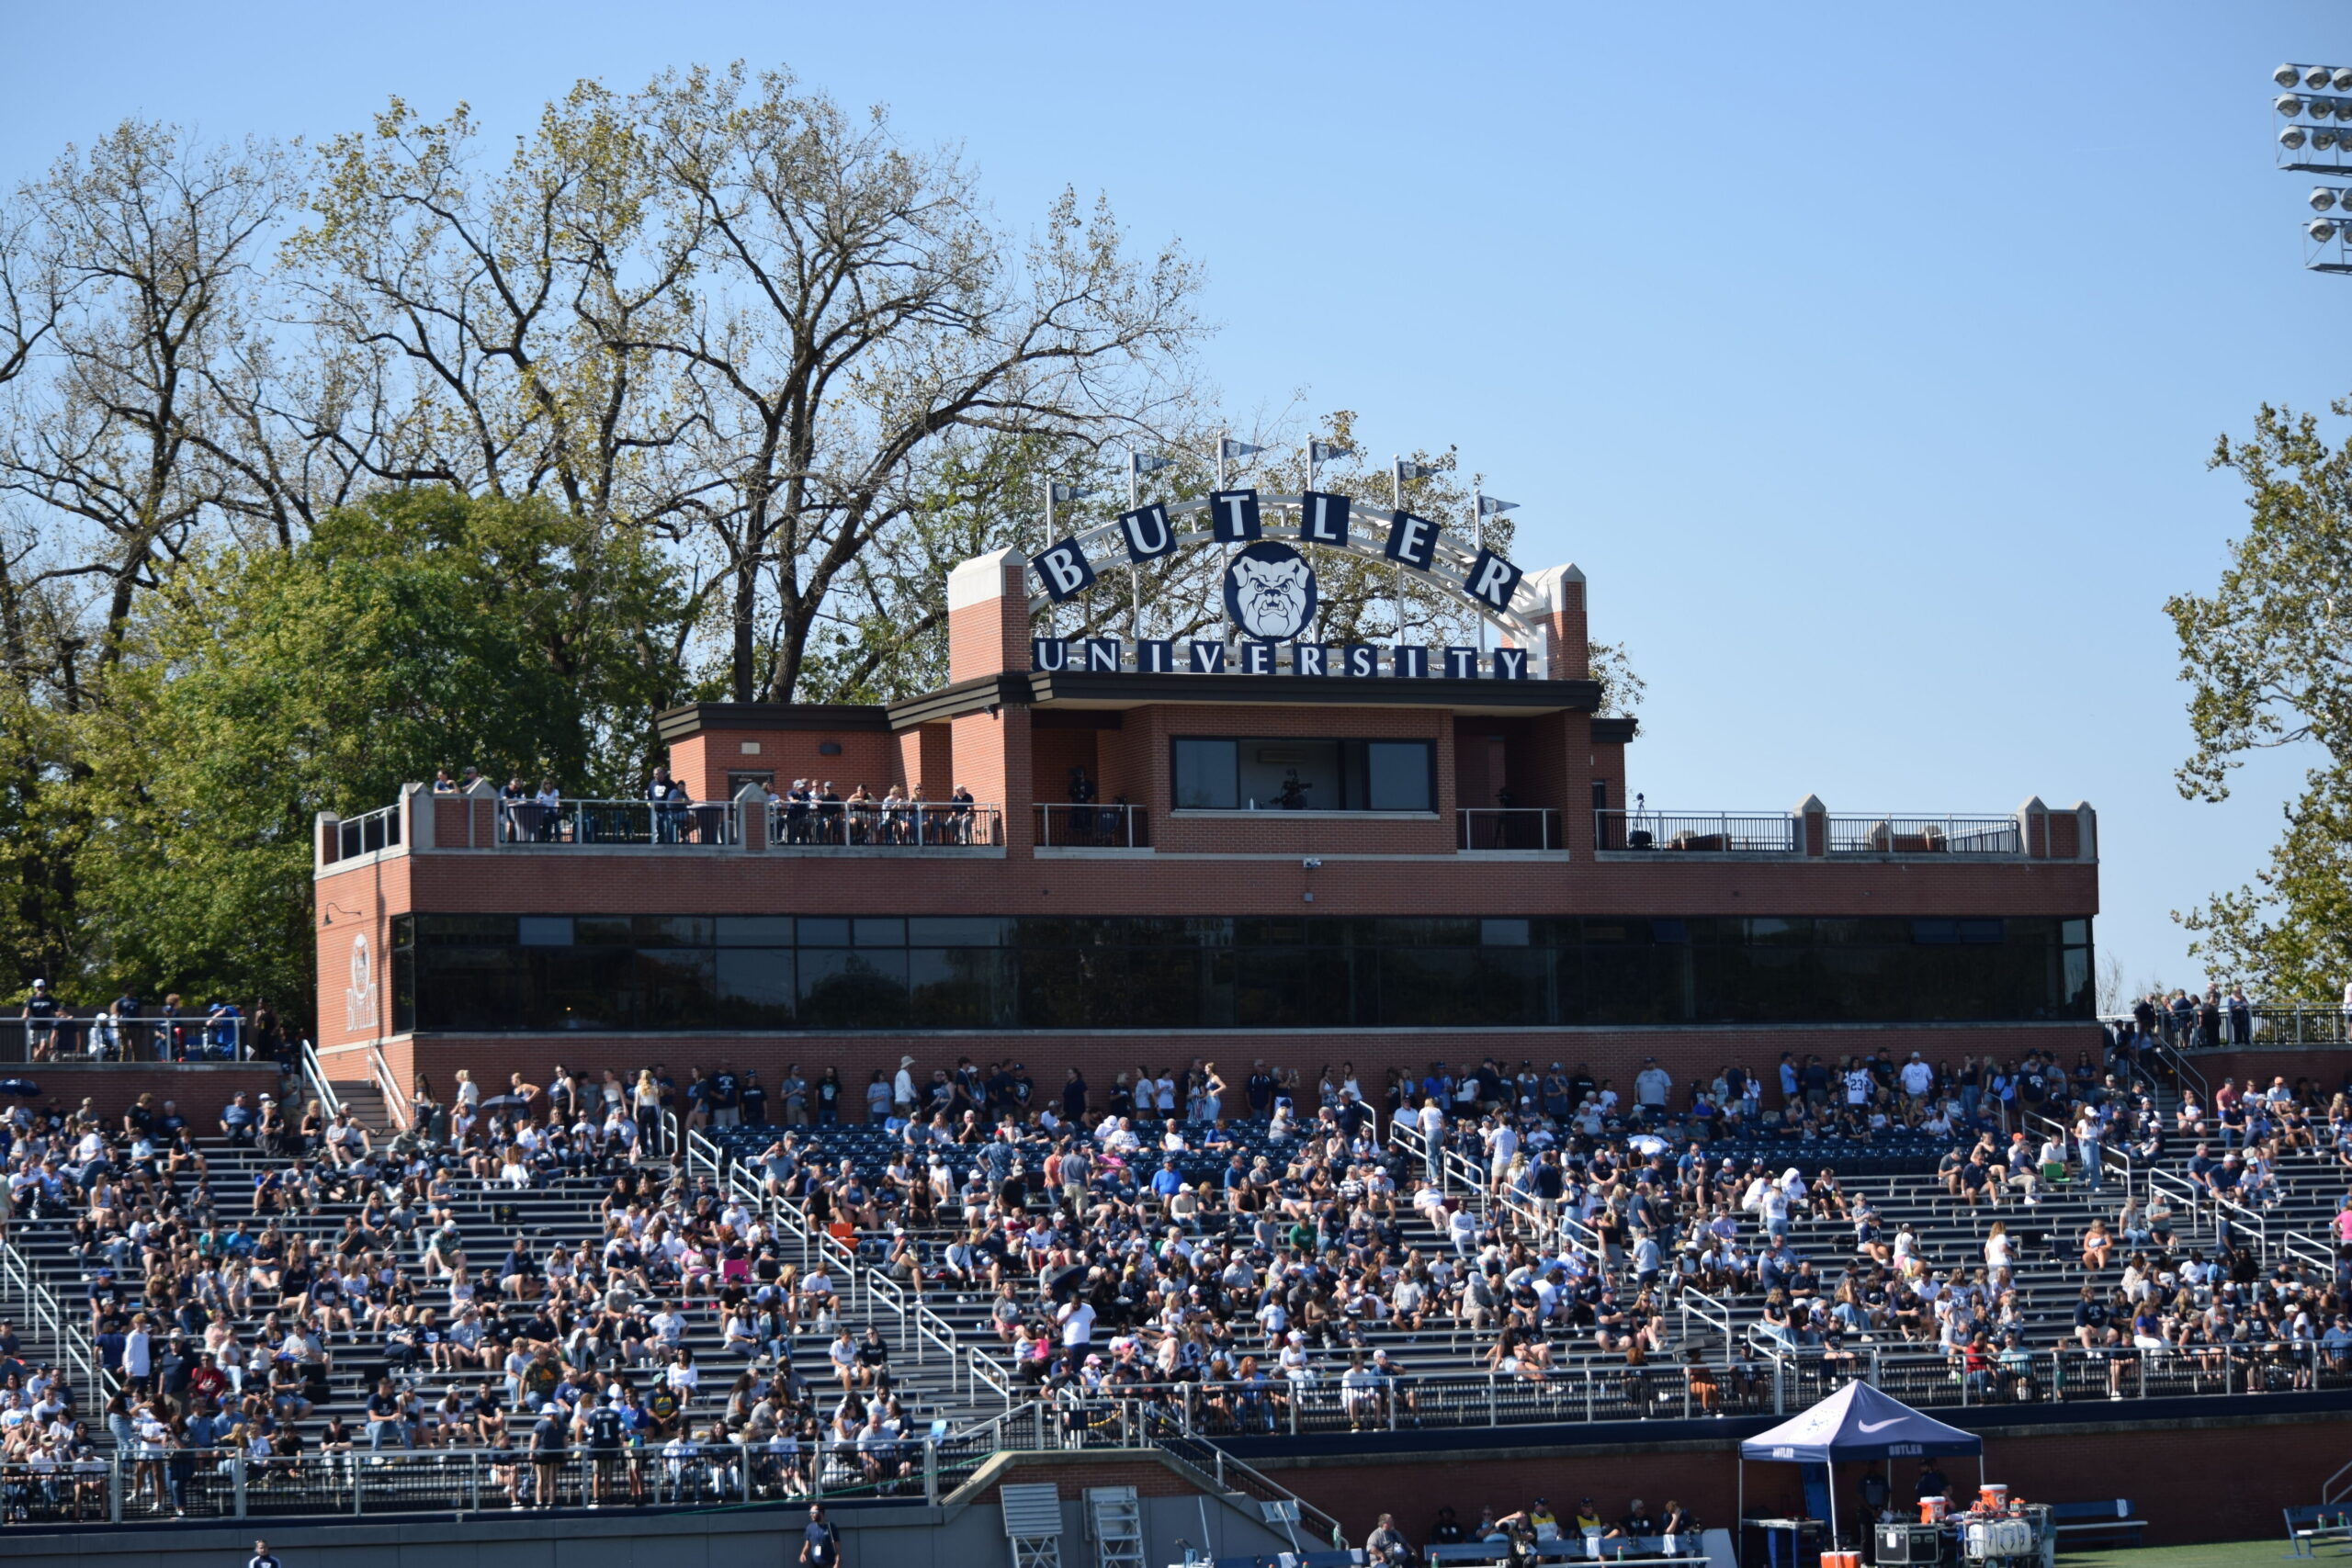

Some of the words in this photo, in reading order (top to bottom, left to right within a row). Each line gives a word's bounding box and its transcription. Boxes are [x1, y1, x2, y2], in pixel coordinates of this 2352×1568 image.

[1044, 494, 1512, 606] BUTLER
[1038, 641, 1522, 680] UNIVERSITY
[345, 983, 378, 1032] BUTLER
[1850, 1078, 1863, 1091] 23
[602, 1422, 610, 1439] 1
[1772, 1447, 1793, 1459] BUTLER
[1889, 1444, 1922, 1455] BUTLER
[1996, 1494, 2006, 1506] G
